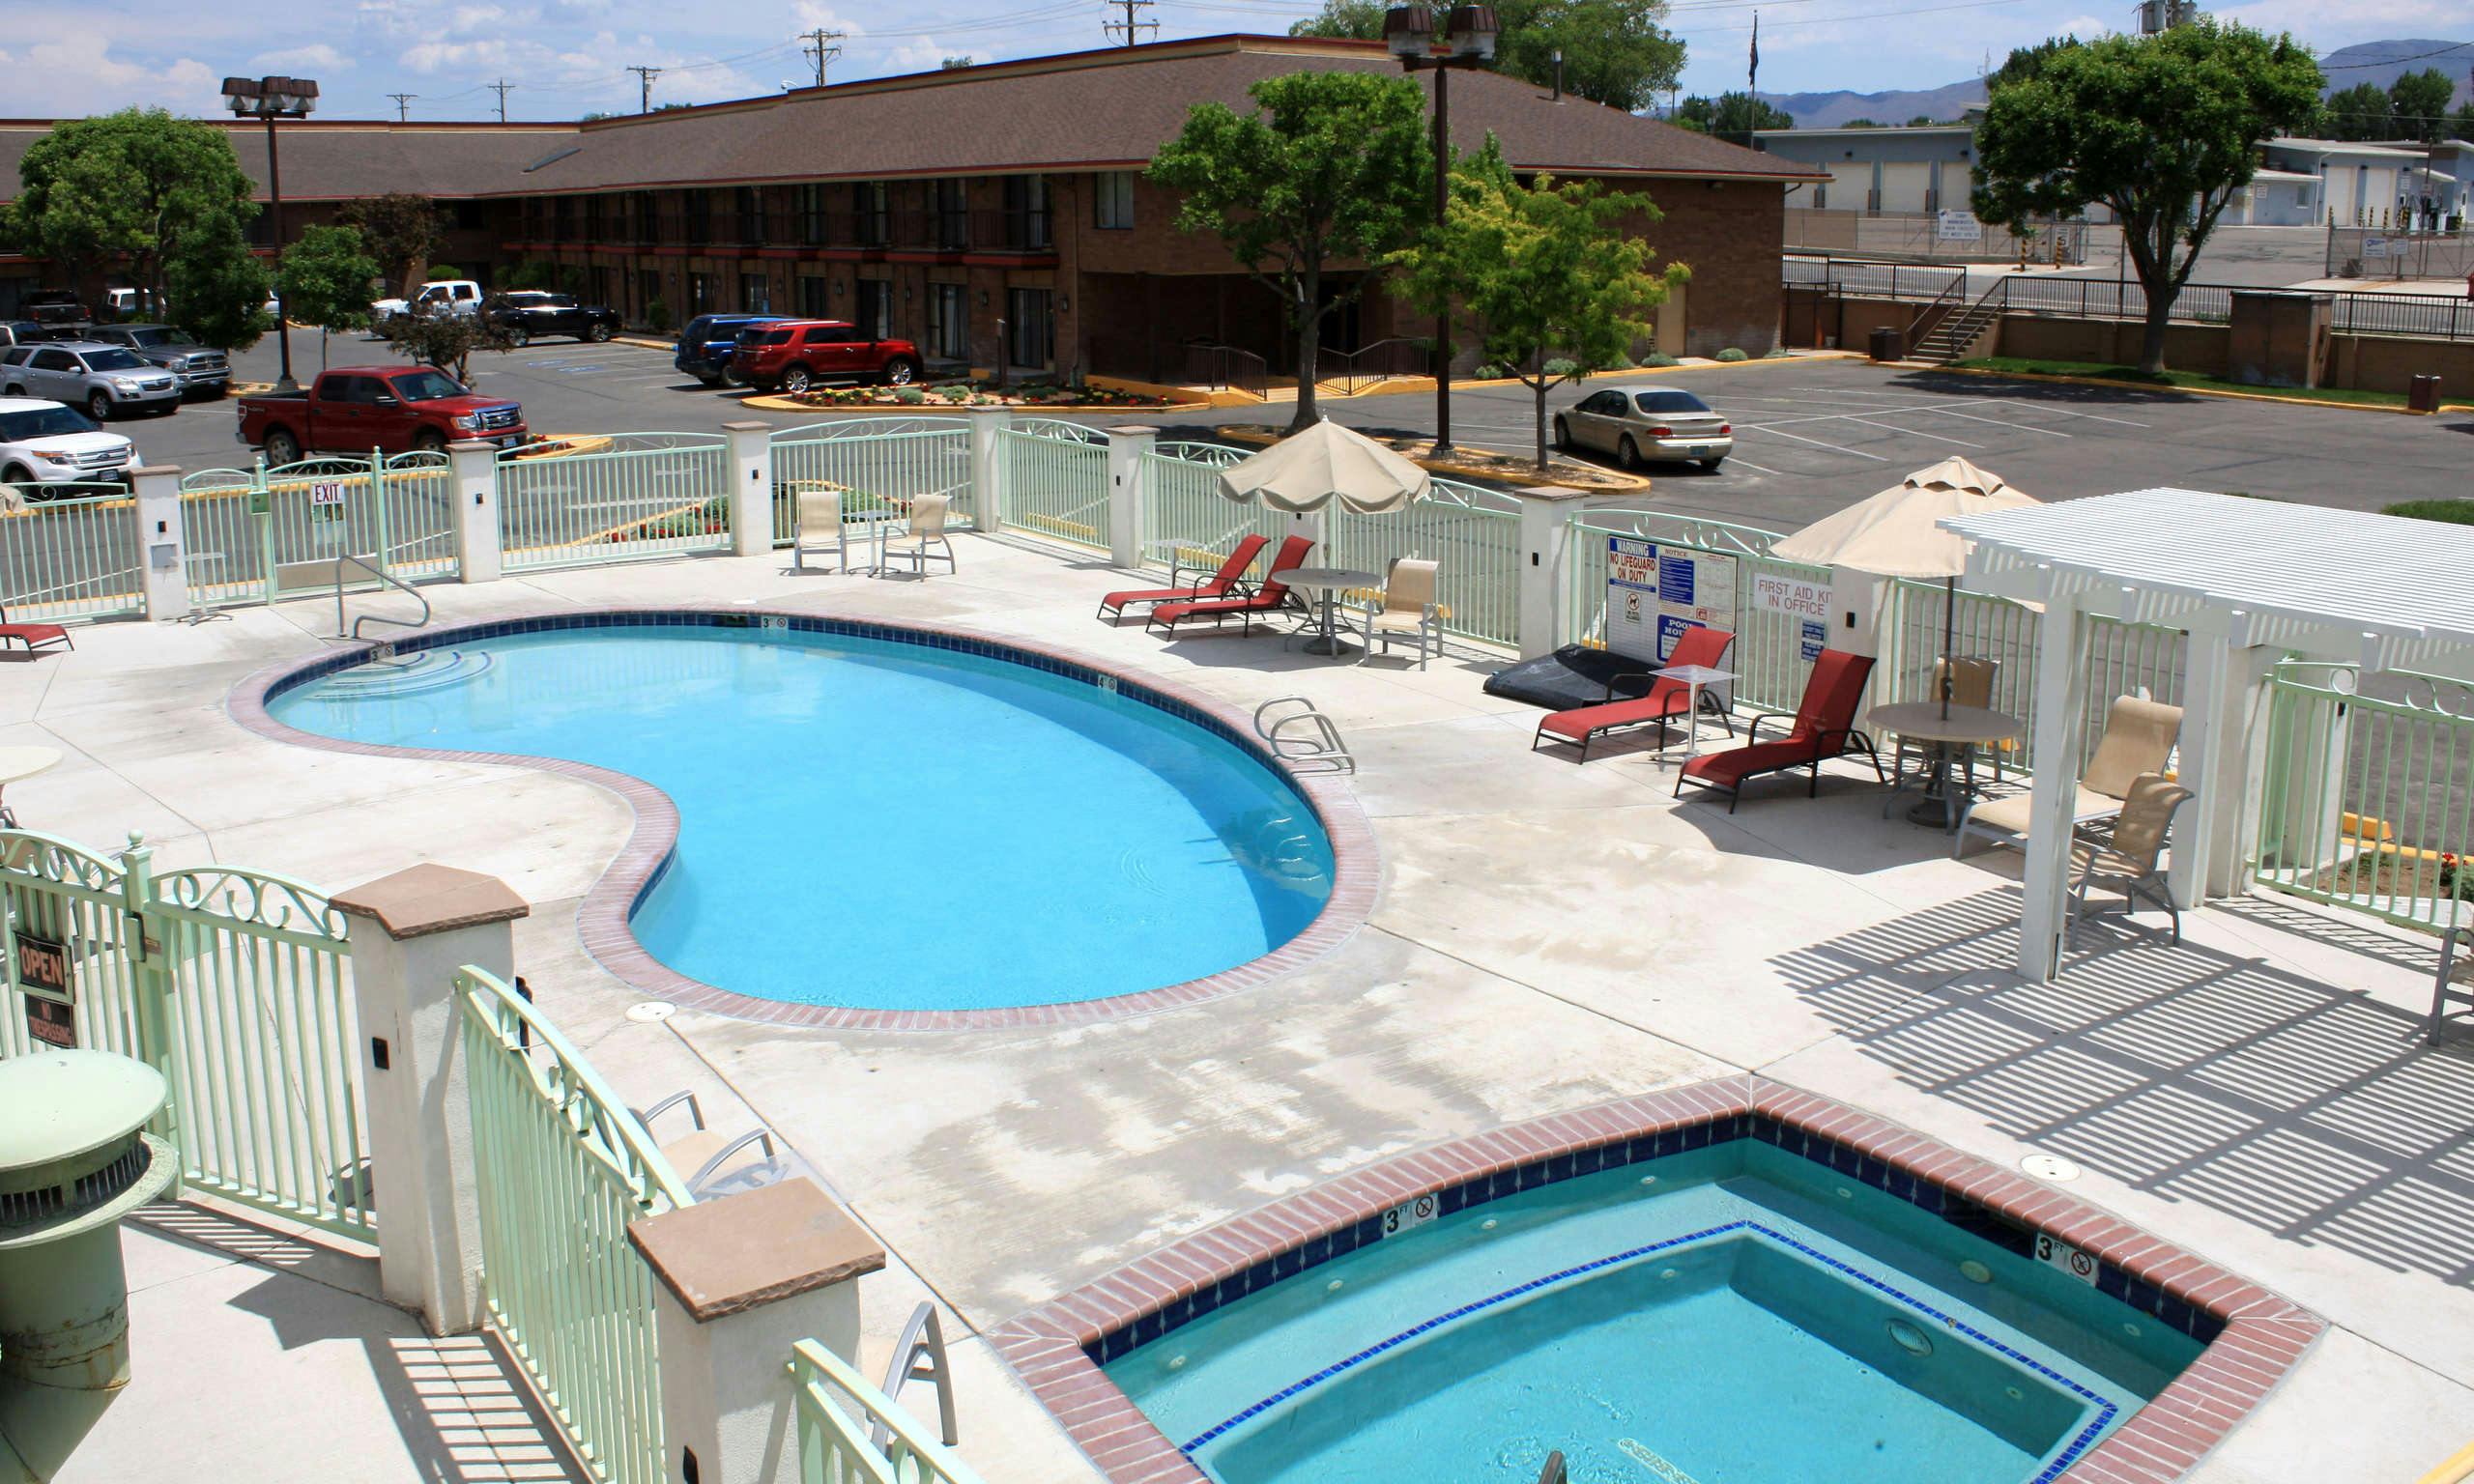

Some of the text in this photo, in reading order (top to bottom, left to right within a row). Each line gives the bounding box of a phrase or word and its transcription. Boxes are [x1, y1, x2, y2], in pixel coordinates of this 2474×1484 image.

[315, 483, 339, 502] EXIT
[1616, 540, 1649, 556] WARNING
[1610, 553, 1655, 572] NO LIFEGUARD
[1617, 566, 1647, 584] ON DUTY
[1759, 580, 1791, 596] FIRST
[1795, 585, 1813, 600] AID
[1769, 594, 1826, 616] IN OFFICE
[763, 617, 769, 627] 3
[372, 650, 378, 661] 3
[20, 944, 64, 986] OPEN
[1387, 1205, 1408, 1233] 3 FT
[2037, 1236, 2065, 1261] 3 FT
